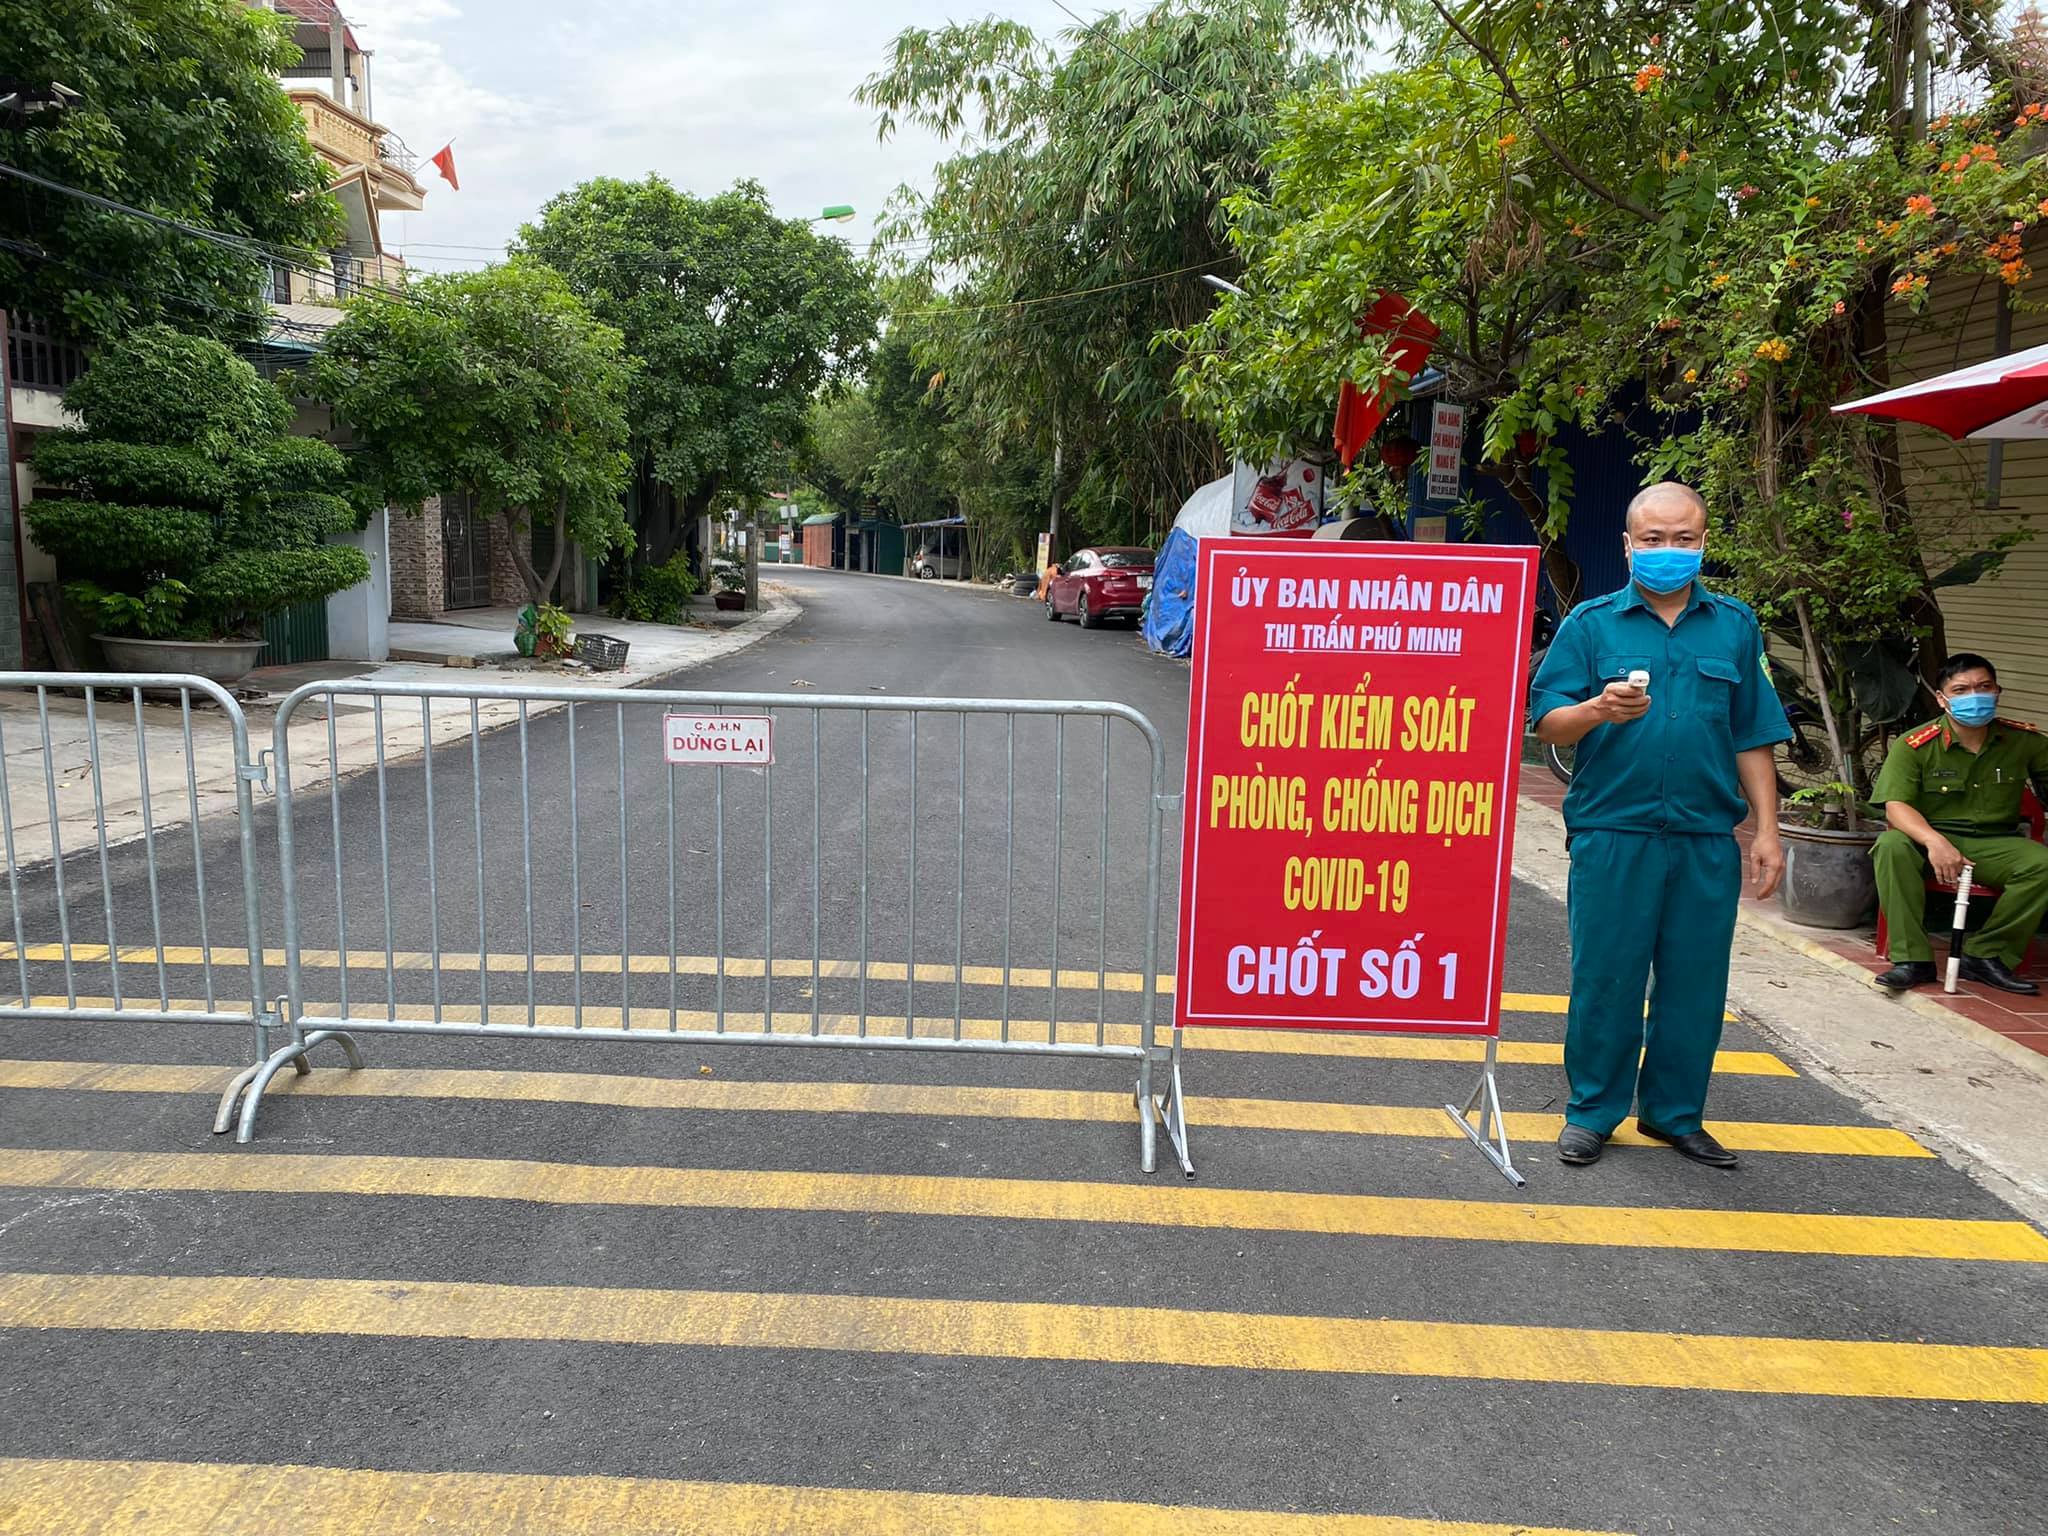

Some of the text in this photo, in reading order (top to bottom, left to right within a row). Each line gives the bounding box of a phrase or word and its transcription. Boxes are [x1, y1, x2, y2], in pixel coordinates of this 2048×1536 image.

[1231, 567, 1504, 615] ỦY BAN NHÂN DÂN
[1264, 613, 1463, 655] THỊ TRẤN PHÚ MINH
[1240, 671, 1476, 753] CHỐT KIỂM SOÁT
[673, 732, 763, 755] DỪNG LẠI
[1210, 758, 1495, 848] PHÒNG, CHỐNG DỊCH
[1283, 855, 1410, 914] COVID-19
[1226, 929, 1459, 1000] CHỐT SỐ 1
